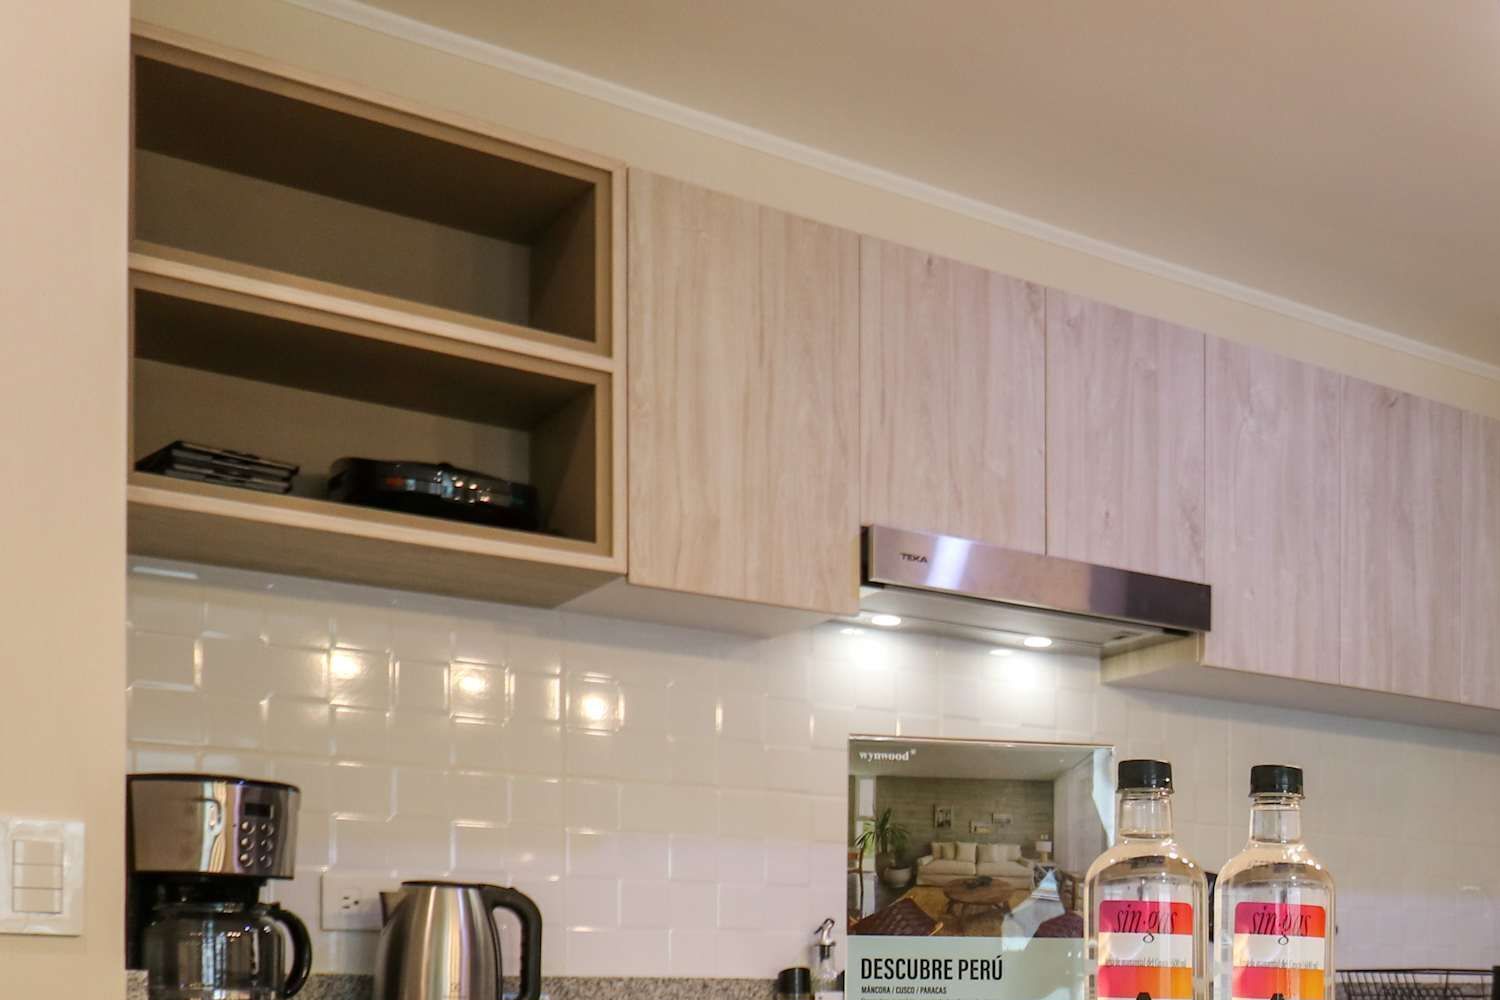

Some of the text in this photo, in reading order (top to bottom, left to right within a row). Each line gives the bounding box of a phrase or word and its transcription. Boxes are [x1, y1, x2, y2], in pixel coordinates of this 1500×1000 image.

[899, 552, 928, 563] TEKA
[861, 954, 1003, 981] DESCUBRE PERÚ
[896, 986, 915, 994] CUSCO
[920, 986, 947, 995] PARACAS
